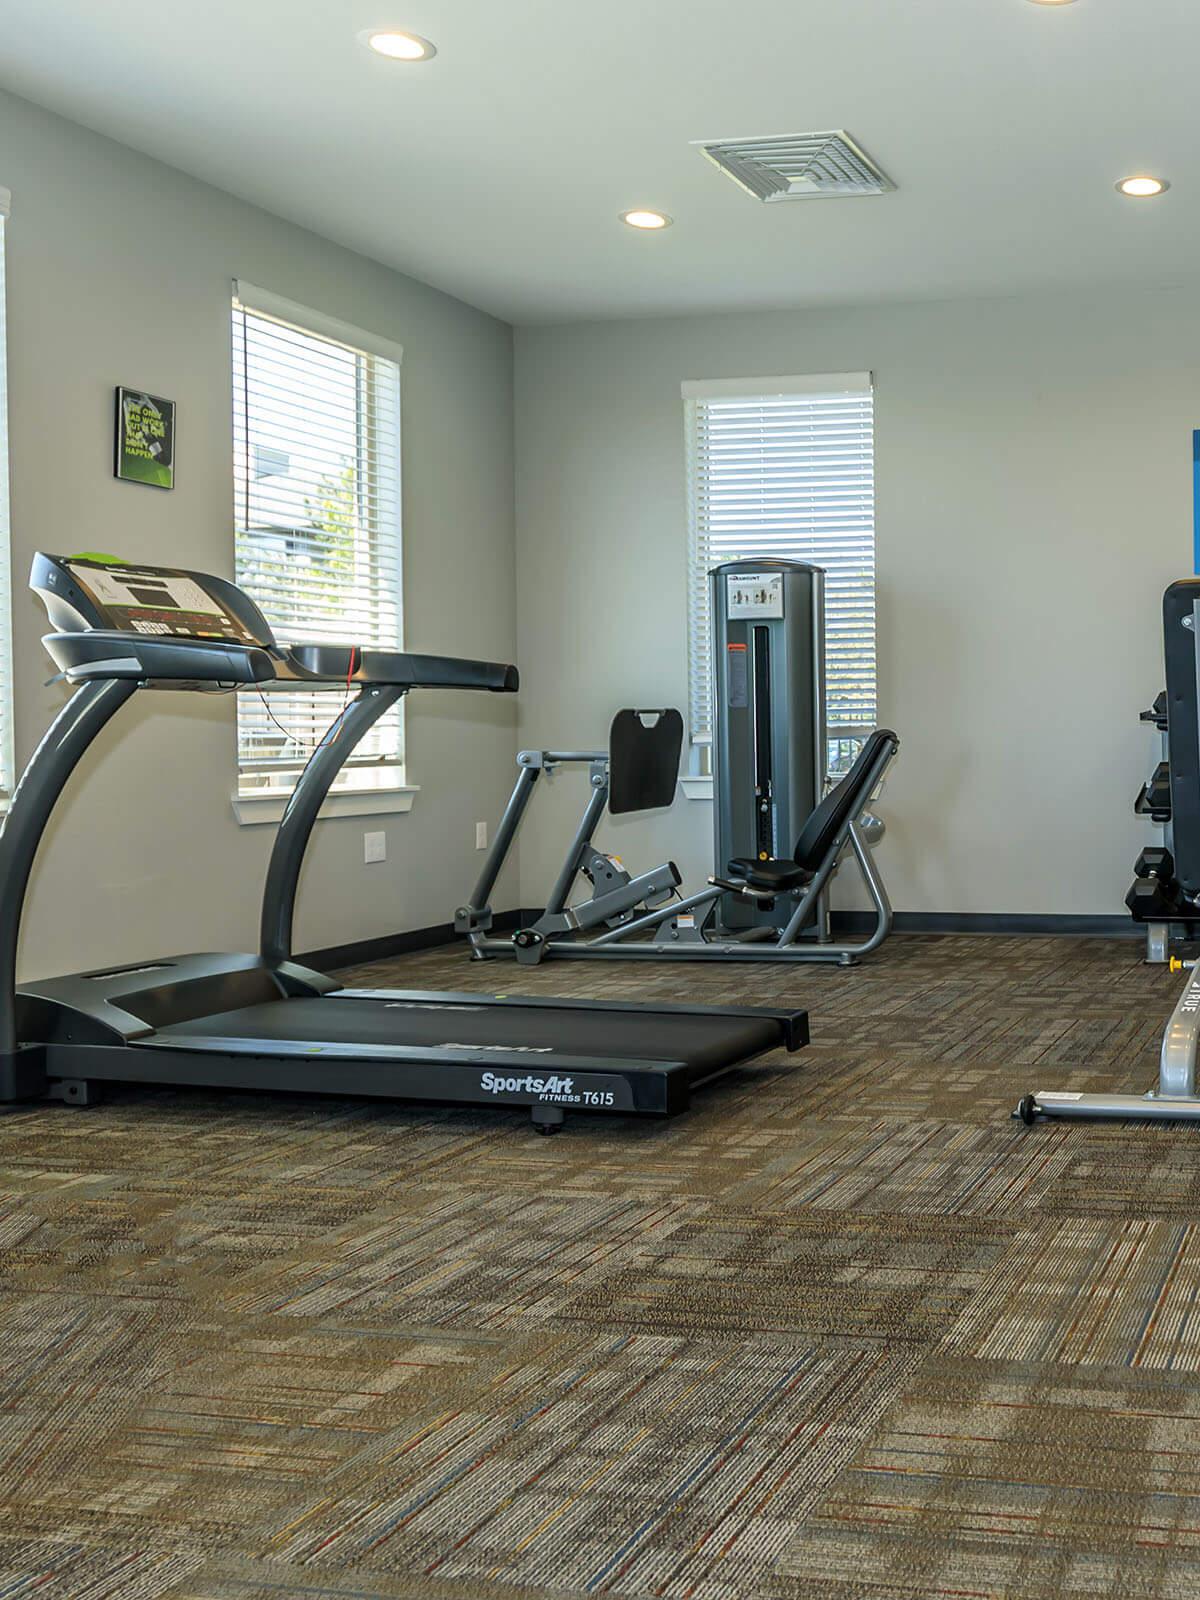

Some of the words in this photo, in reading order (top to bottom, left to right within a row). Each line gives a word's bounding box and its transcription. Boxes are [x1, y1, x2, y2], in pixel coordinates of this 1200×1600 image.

[480, 1072, 574, 1094] SportsArt
[539, 1094, 581, 1102] FITNESS
[583, 1092, 614, 1105] T615
